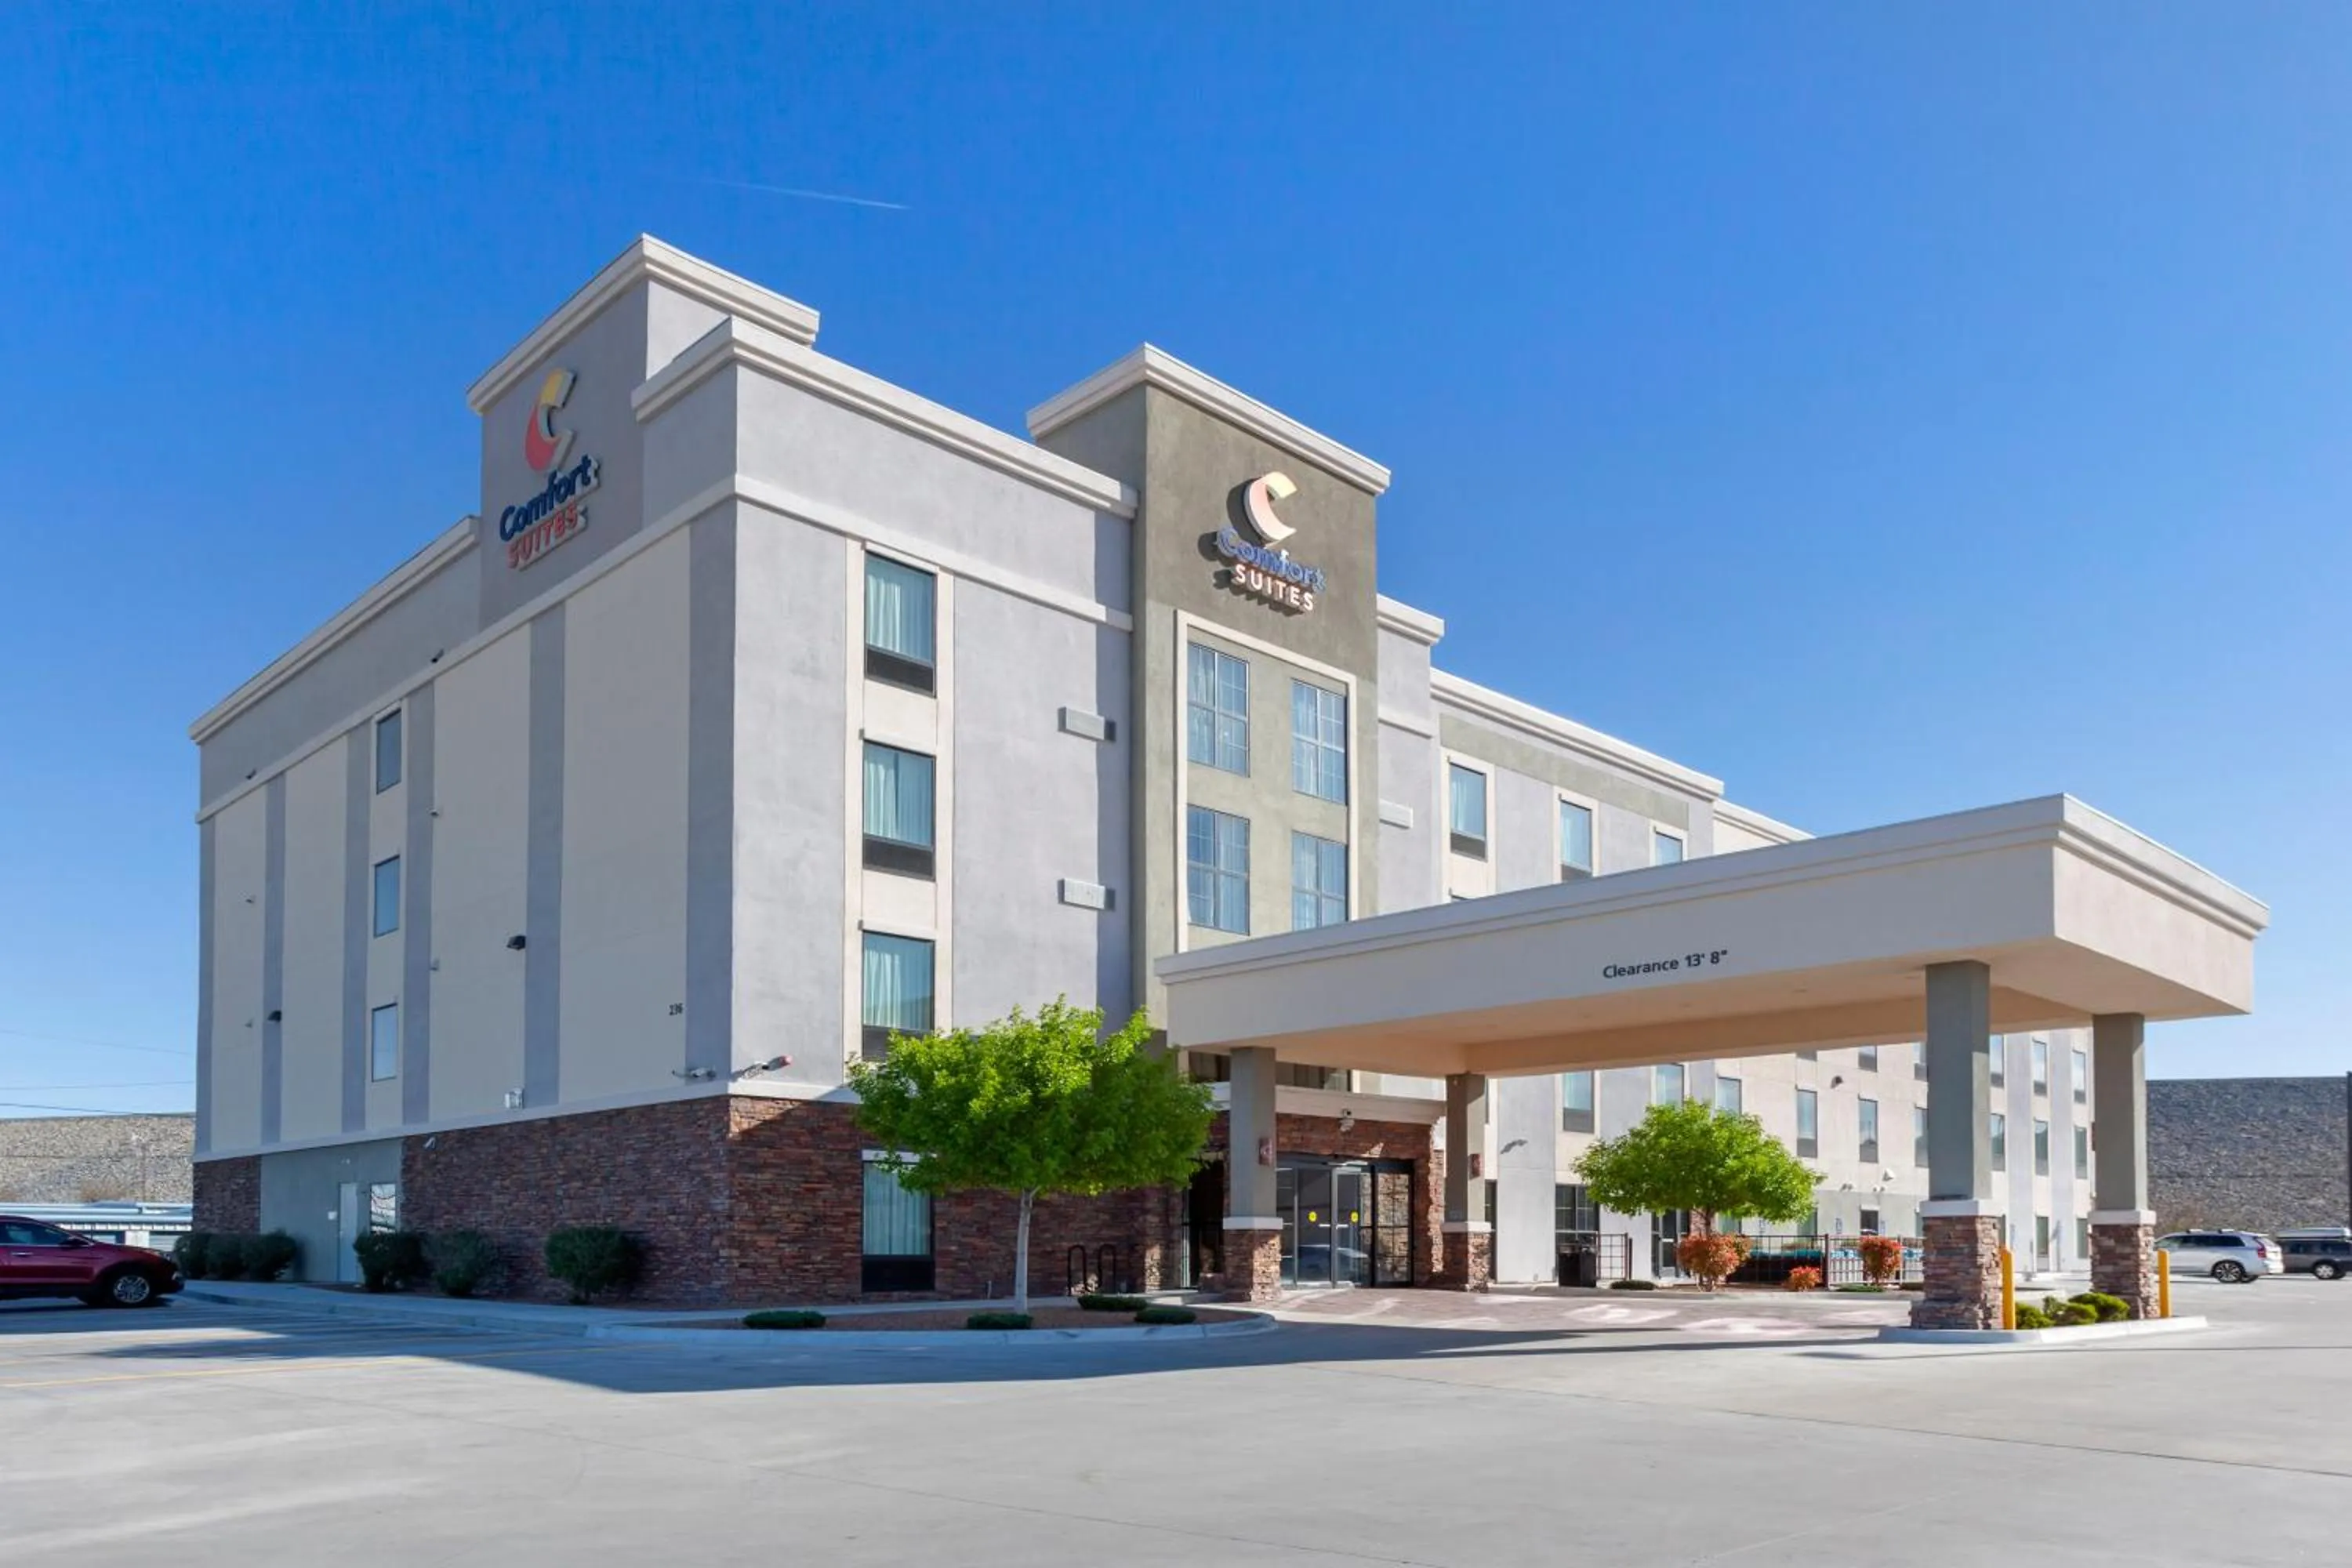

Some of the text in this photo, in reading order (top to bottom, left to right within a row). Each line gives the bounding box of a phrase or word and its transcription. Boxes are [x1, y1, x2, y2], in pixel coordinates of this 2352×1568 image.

[499, 454, 594, 542] Comfort
[506, 496, 579, 569] SUITES
[1216, 526, 1327, 592] Comfort
[1233, 564, 1315, 611] SUITES
[1602, 949, 1728, 978] Clearance 13' 8"
